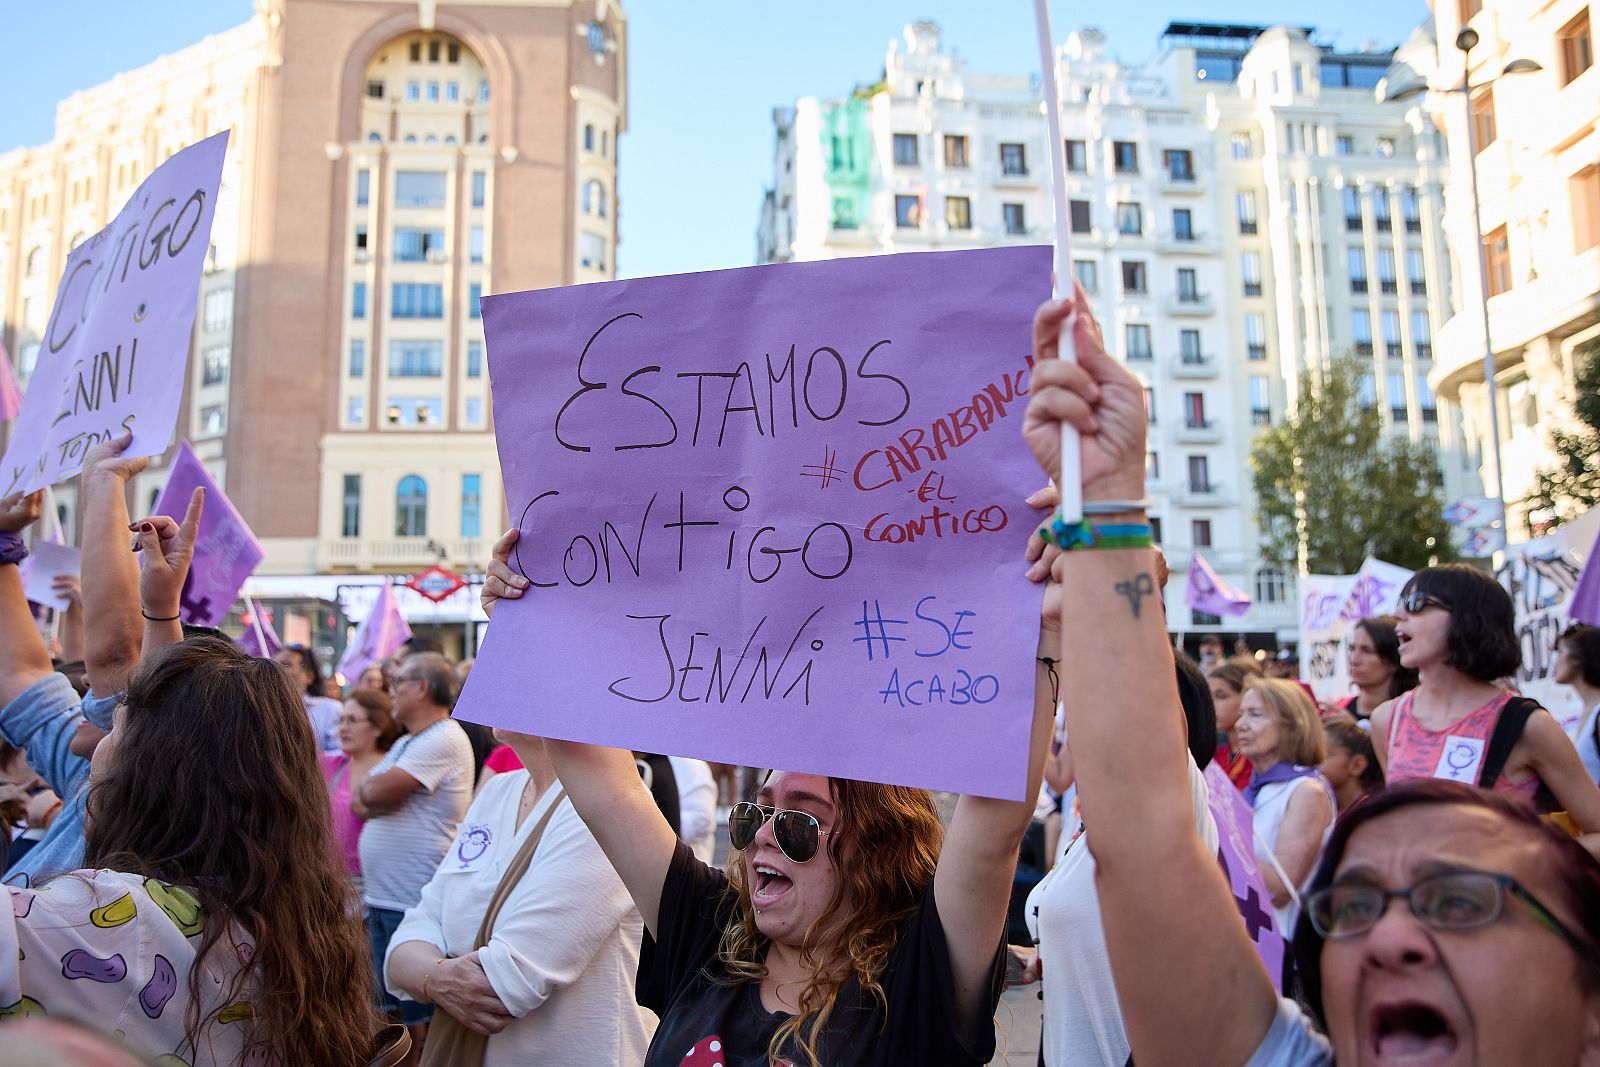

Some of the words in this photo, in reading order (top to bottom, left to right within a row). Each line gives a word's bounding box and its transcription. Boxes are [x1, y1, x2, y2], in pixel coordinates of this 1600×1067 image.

[555, 312, 910, 453] ESTAMOS
[799, 354, 1036, 492] #CARABANC
[852, 596, 976, 661] #SE
[878, 669, 1000, 708] ACABO
